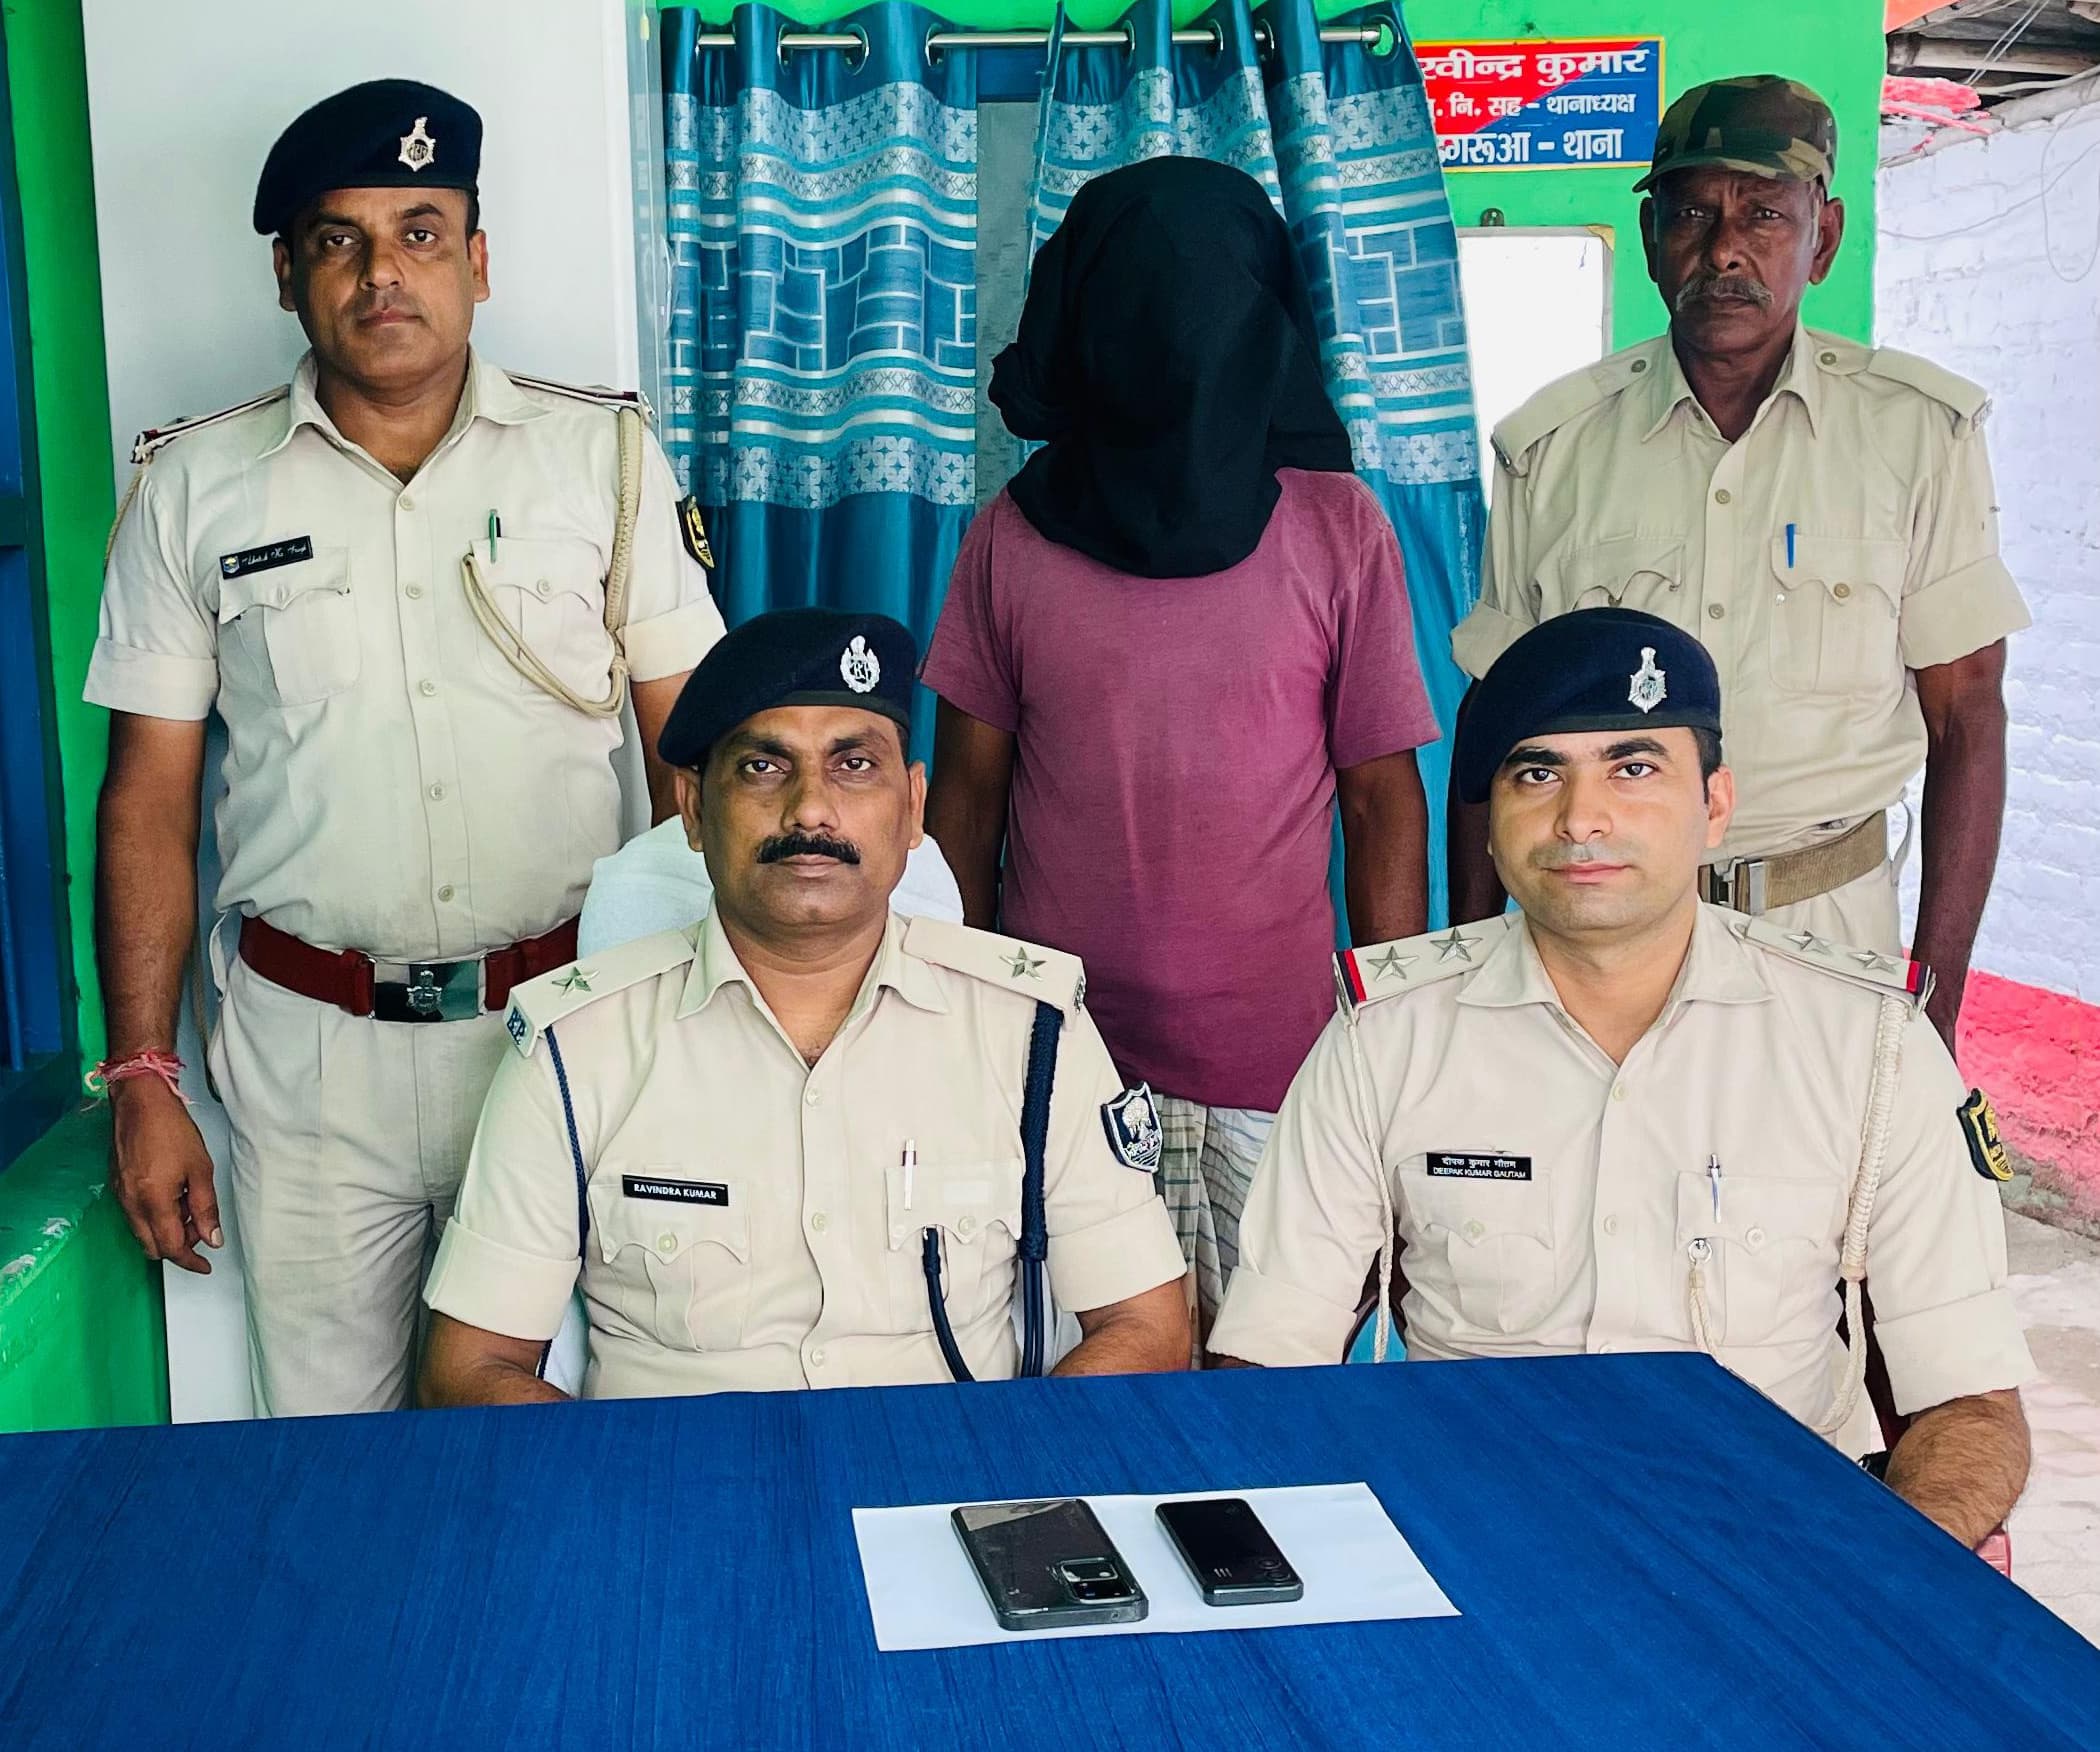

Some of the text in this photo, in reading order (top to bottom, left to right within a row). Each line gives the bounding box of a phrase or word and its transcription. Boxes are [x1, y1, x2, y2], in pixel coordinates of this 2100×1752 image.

[1417, 48, 1650, 86] रवीन्द्र कुमार
[1449, 91, 1481, 117] नि.
[1487, 96, 1524, 117] सह
[1546, 94, 1636, 115] थानाध्यक्ष
[1563, 129, 1624, 159] थाना
[1433, 1167, 1463, 1175] DEEPAK
[1465, 1169, 1492, 1177] KUMAR
[1469, 1159, 1490, 1168] कुमार
[634, 1184, 716, 1199] RAVINDRA KUMAR
